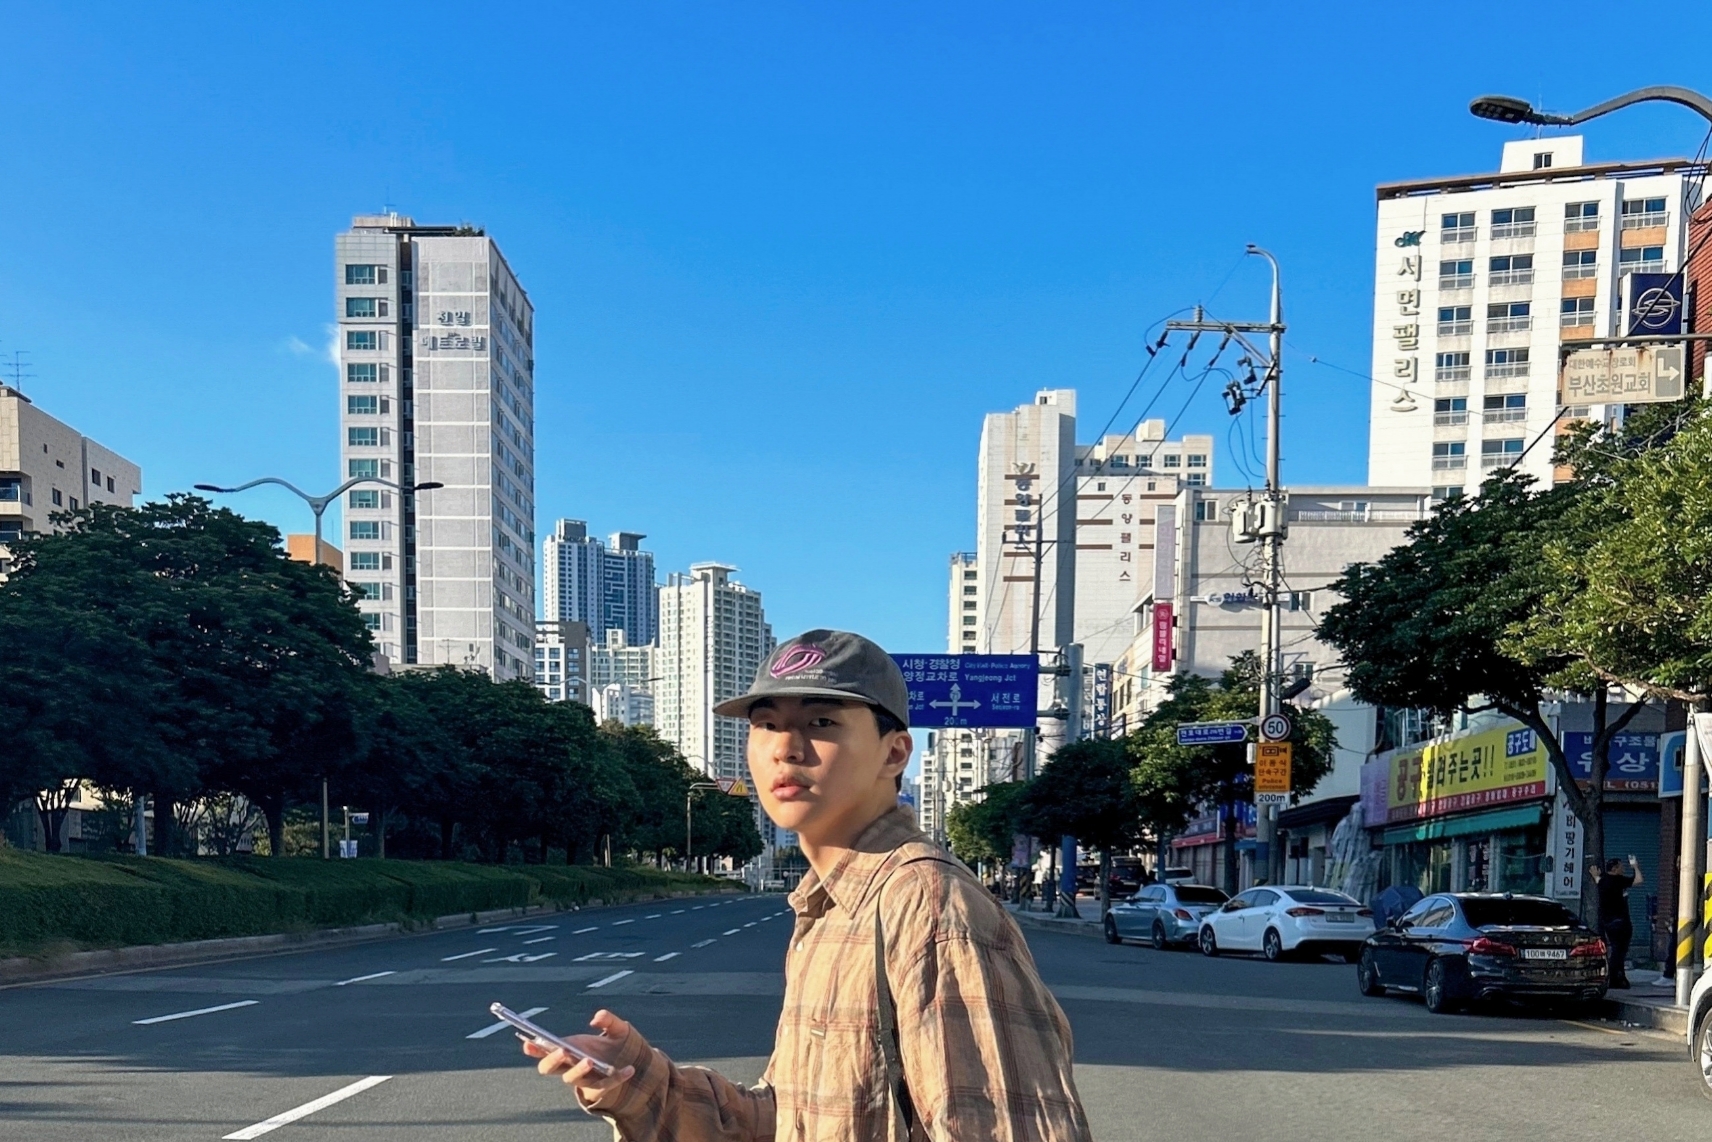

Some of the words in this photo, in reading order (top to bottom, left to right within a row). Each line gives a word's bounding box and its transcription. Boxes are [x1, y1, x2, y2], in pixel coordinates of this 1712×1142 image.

[1390, 254, 1423, 413] 서면팰리스
[1568, 371, 1651, 398] 부산초원교회
[902, 671, 959, 682] 양정교차로
[964, 673, 1003, 683] Yangjeong
[1004, 674, 1017, 682] Jct
[908, 690, 925, 701] 차로
[990, 692, 1021, 704] 서전로
[1267, 721, 1284, 734] 50
[1258, 768, 1287, 776] 단속구간
[1258, 794, 1286, 802] 200m
